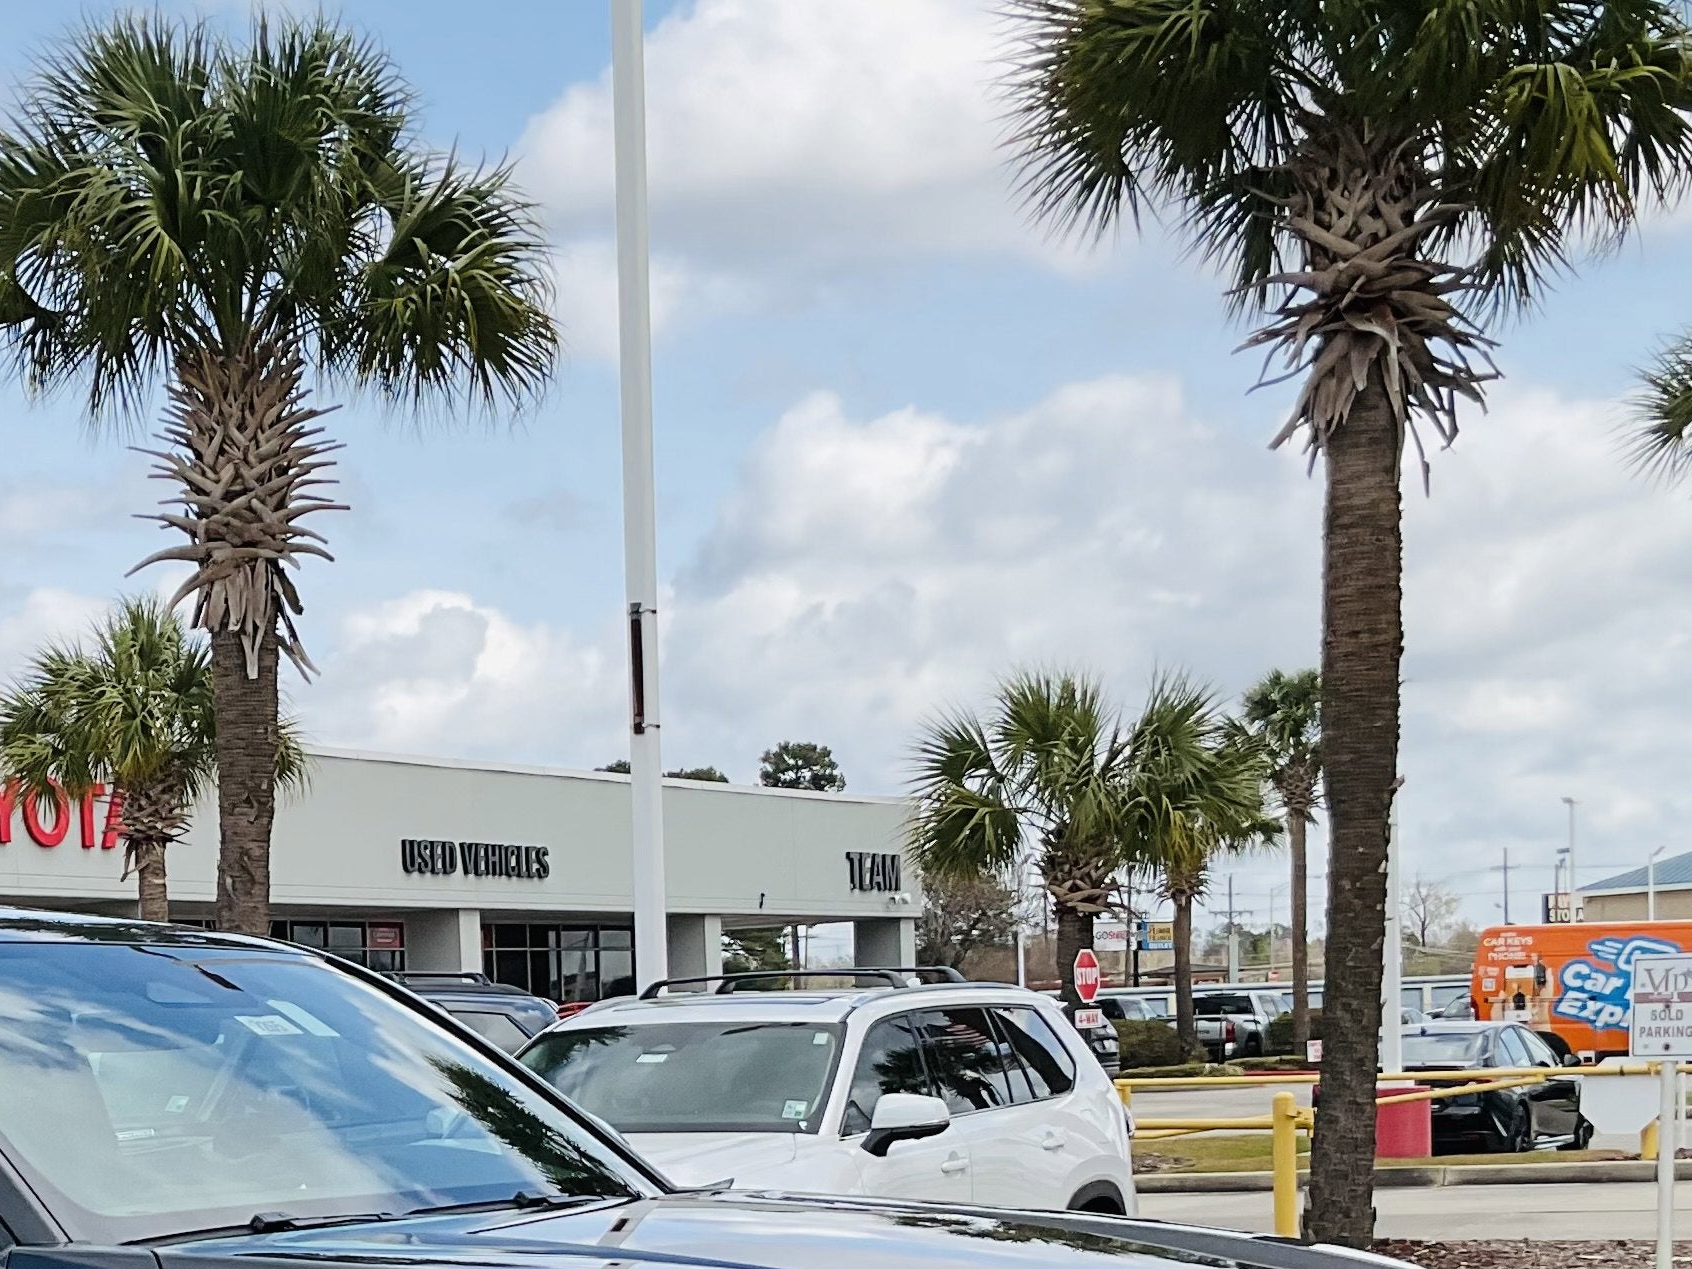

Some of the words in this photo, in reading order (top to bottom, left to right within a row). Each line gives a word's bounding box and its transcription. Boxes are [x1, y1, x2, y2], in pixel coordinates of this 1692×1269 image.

[401, 839, 458, 875] USED
[459, 842, 550, 879] VEHICLES
[845, 851, 901, 893] TEAM
[1483, 937, 1505, 947] CAR
[1507, 936, 1533, 946] KEYS
[1076, 967, 1099, 985] STOP
[1563, 963, 1624, 993] Car
[1078, 1013, 1099, 1024] 4-WAY
[1650, 1009, 1684, 1021] SOLD
[1639, 1026, 1692, 1038] PARKING
